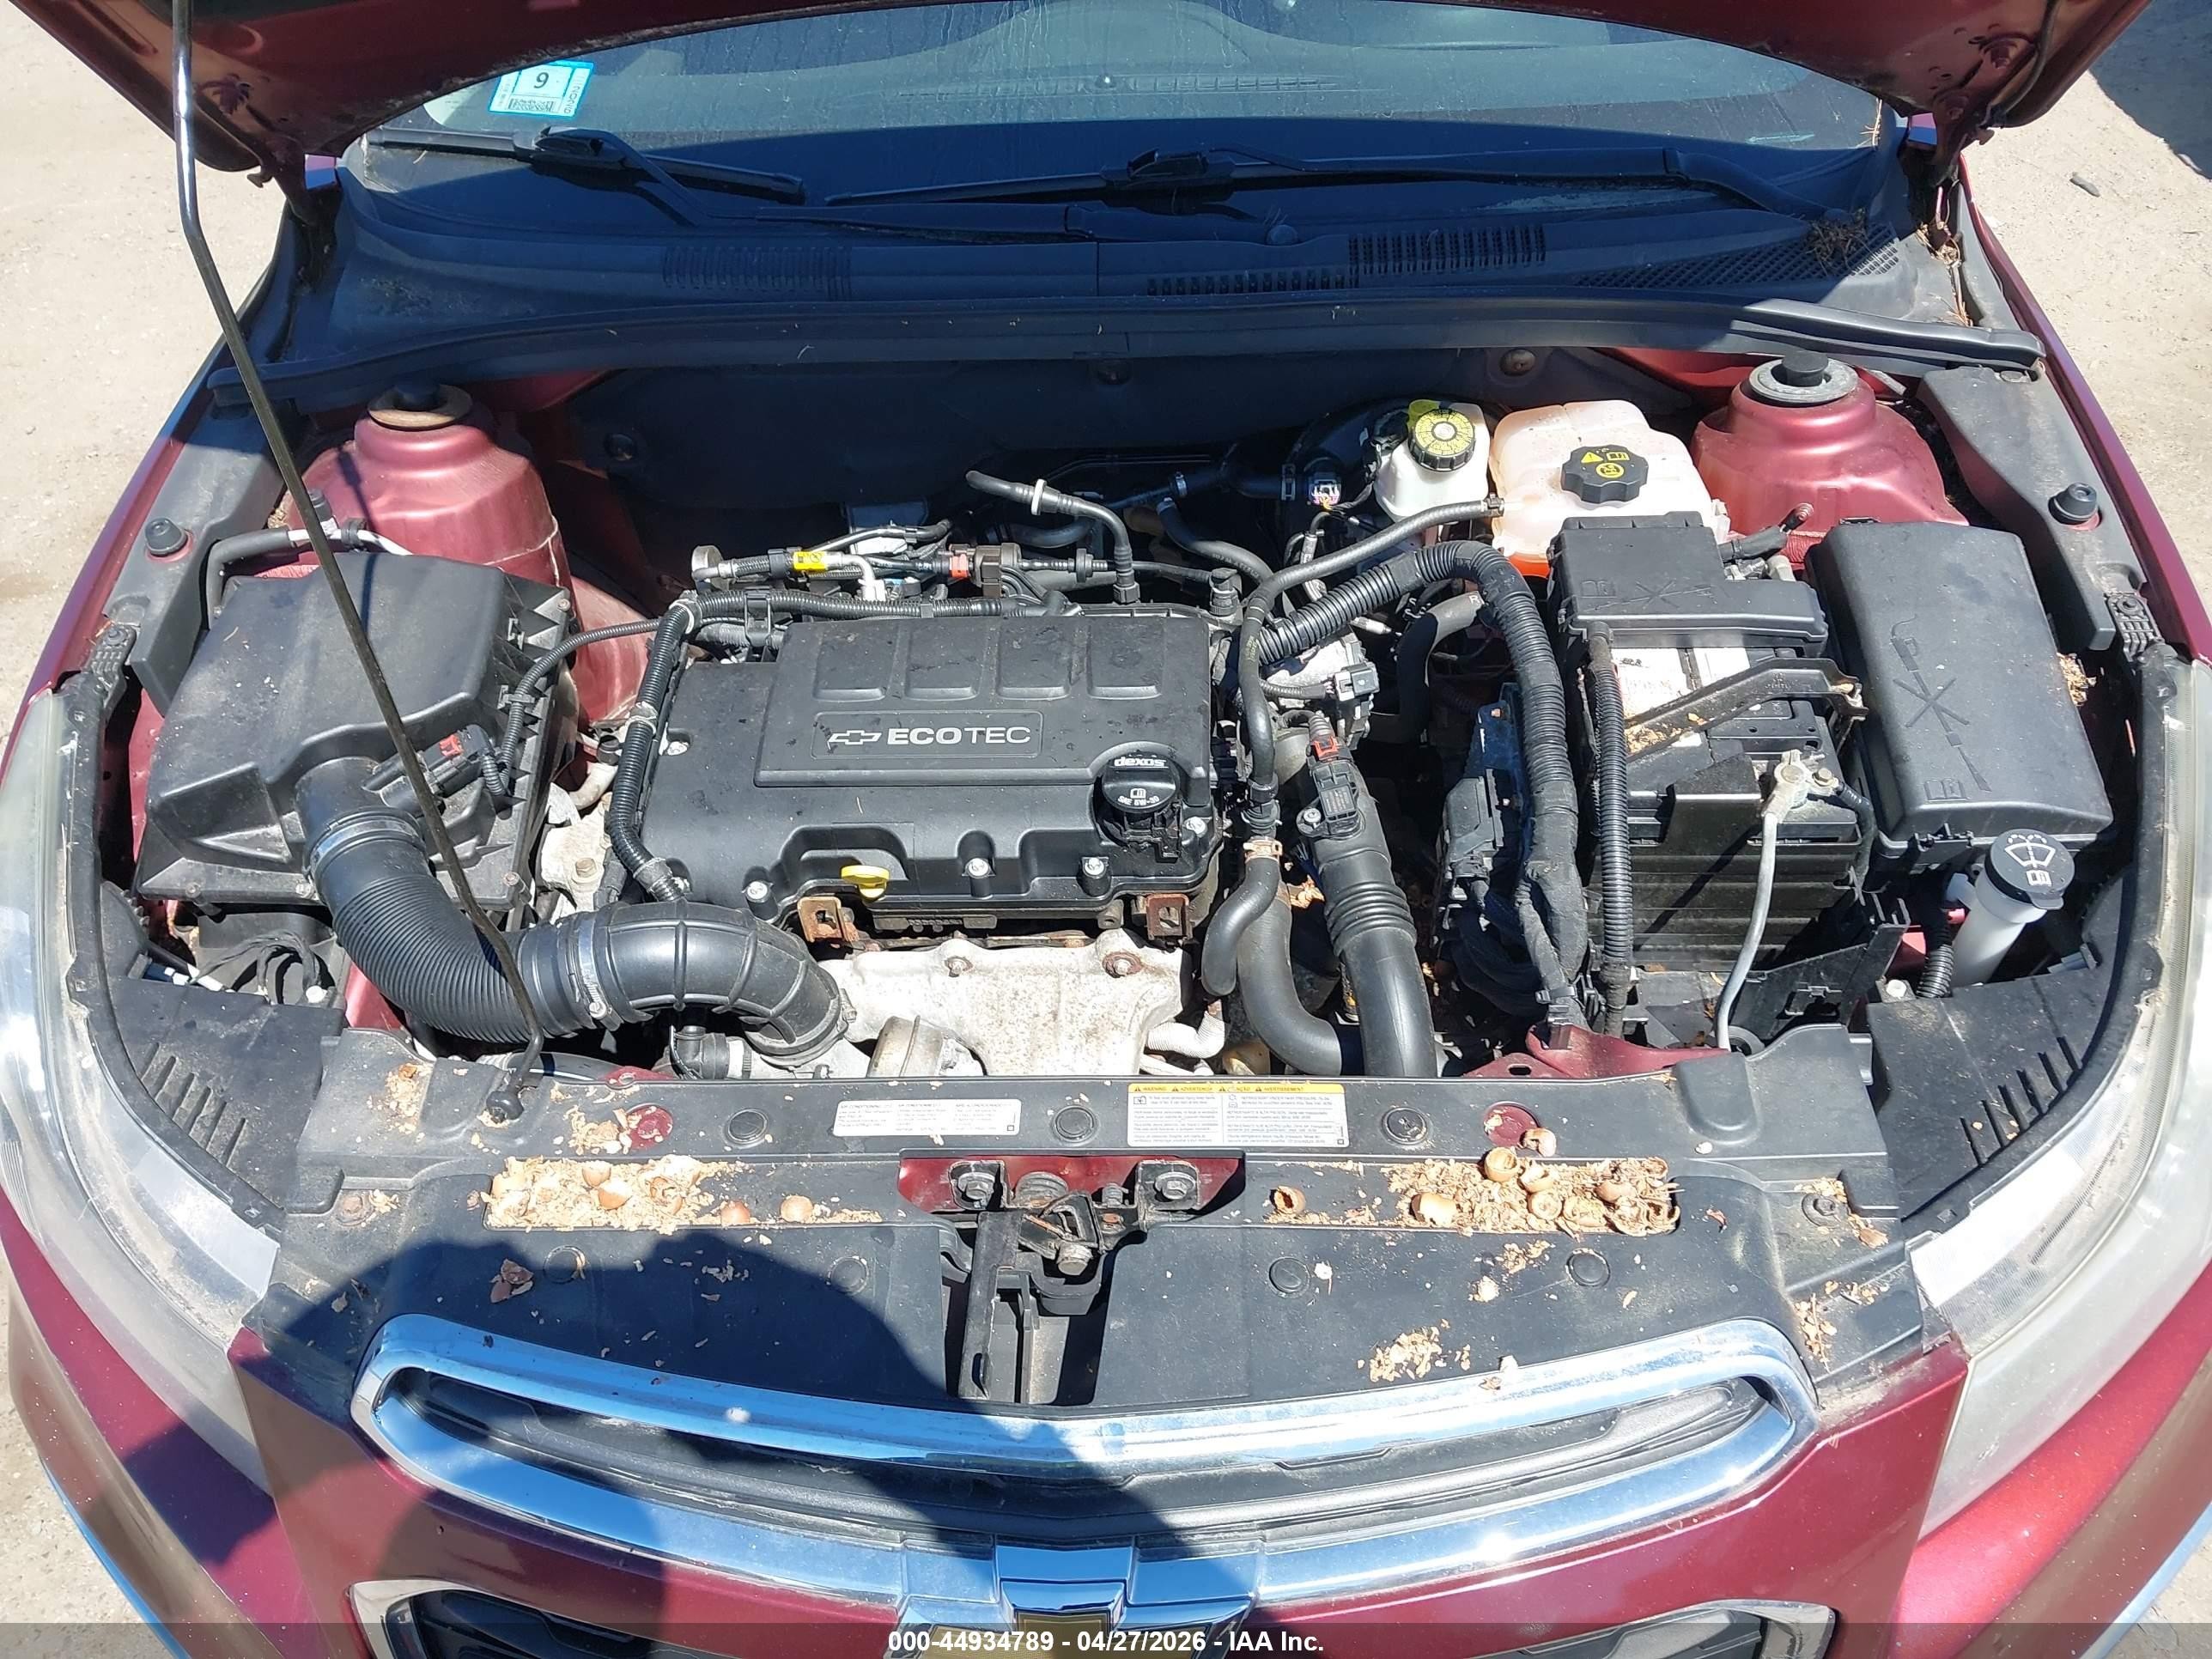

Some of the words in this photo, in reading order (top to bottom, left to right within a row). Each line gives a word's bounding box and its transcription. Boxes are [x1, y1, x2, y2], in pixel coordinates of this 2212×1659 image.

[533, 71, 550, 89] 9
[886, 726, 1031, 745] ECOTEC
[1114, 757, 1167, 767] dexos
[1117, 795, 1133, 805] SAE
[1133, 795, 1160, 806] 5W-30
